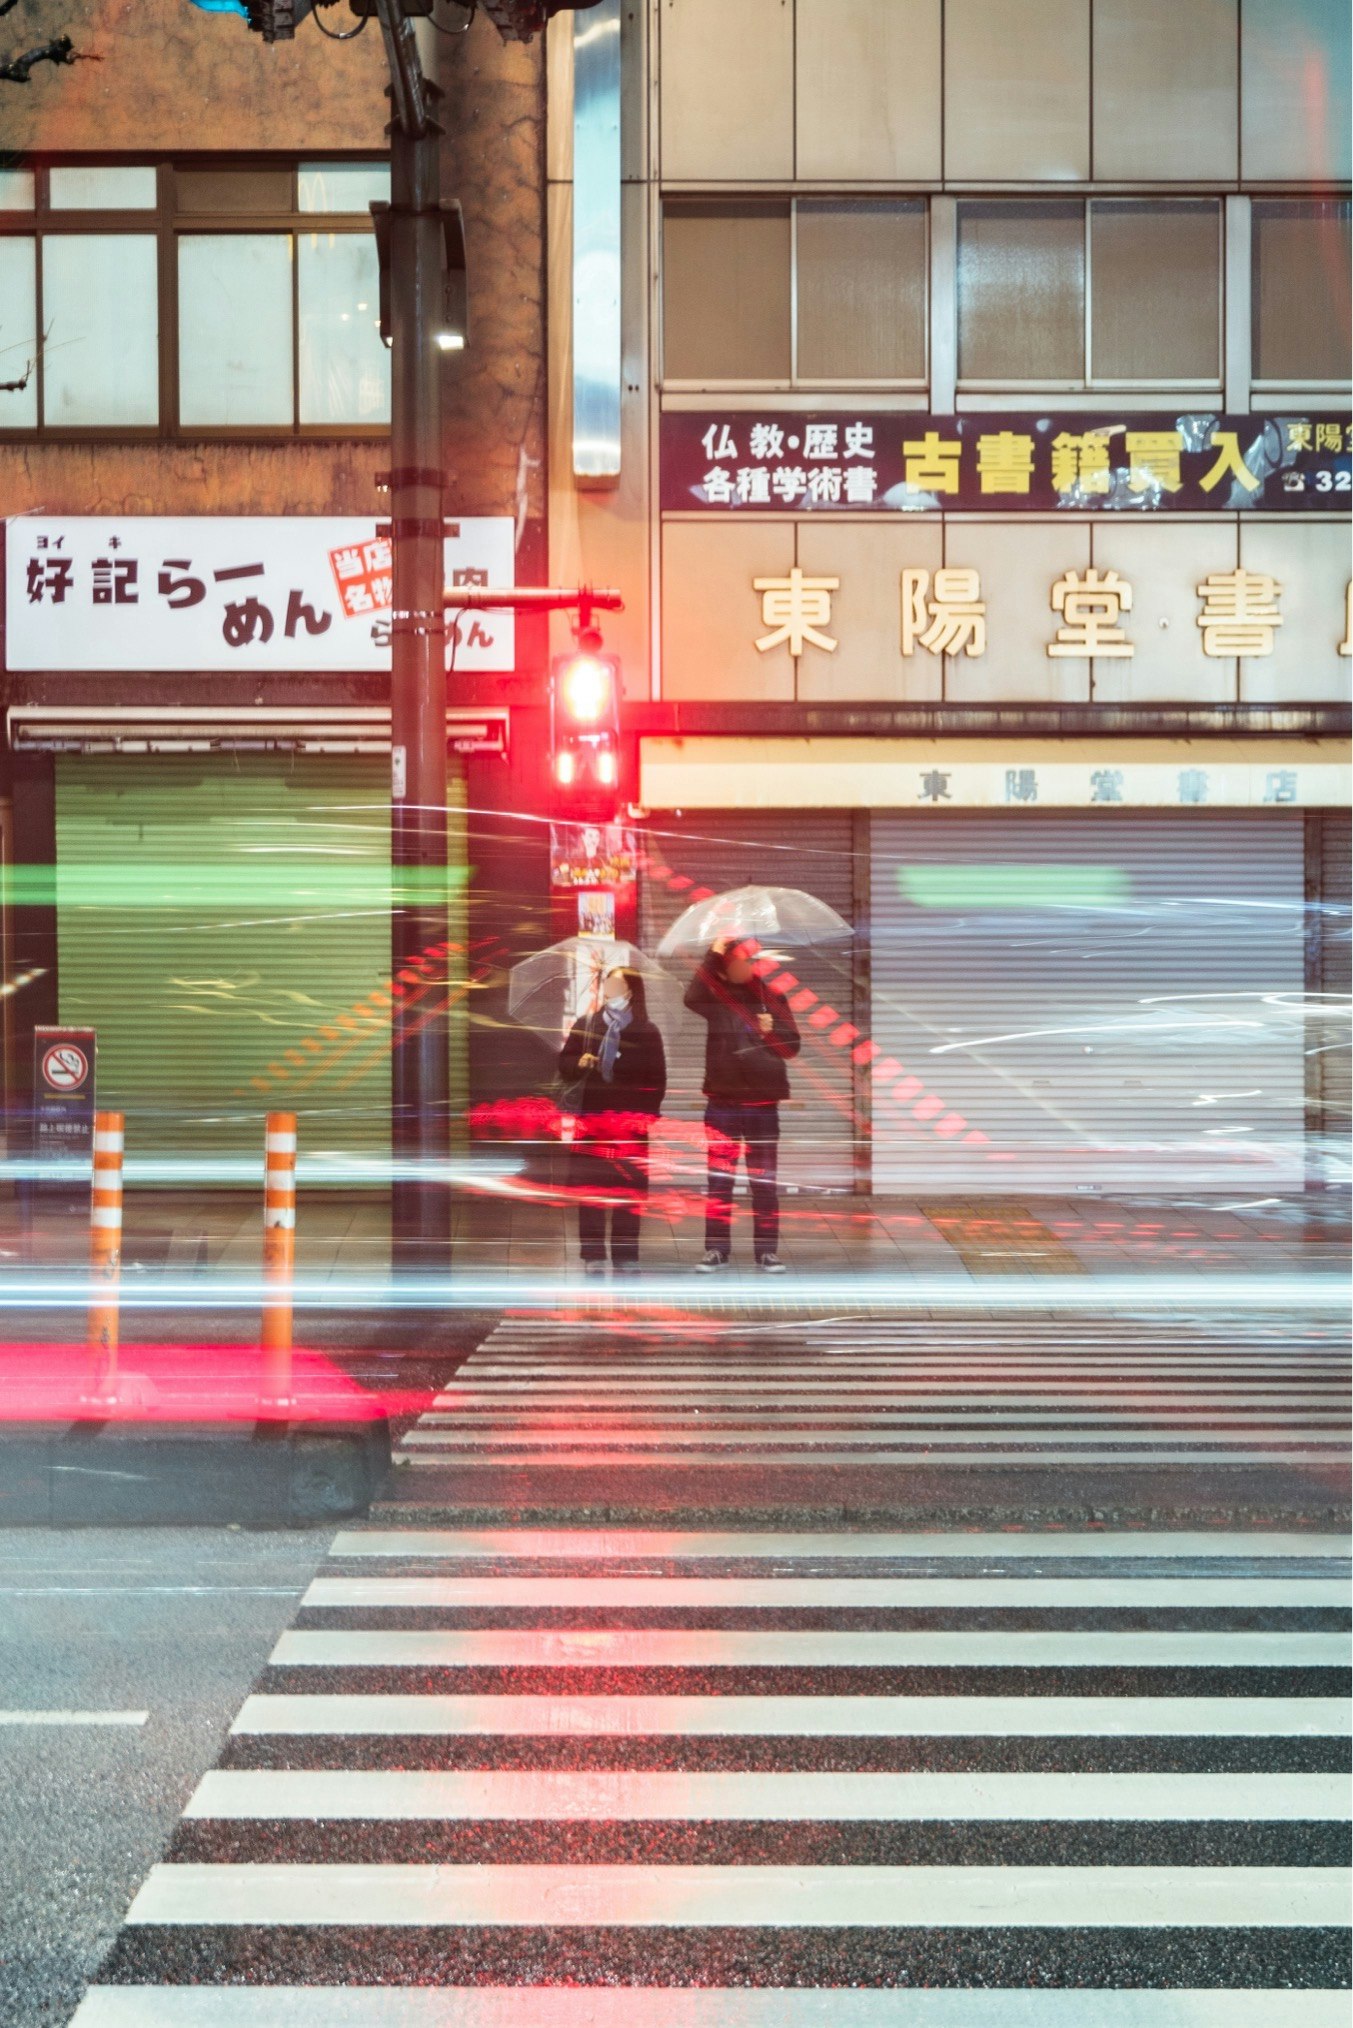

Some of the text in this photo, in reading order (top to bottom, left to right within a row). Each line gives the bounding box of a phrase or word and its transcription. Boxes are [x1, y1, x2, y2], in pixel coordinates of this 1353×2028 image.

[702, 422, 875, 460] 仏教・歴史
[1286, 422, 1352, 453] 東陽
[902, 431, 1261, 495] 古書籍買入
[703, 466, 878, 503] 各種学術書
[752, 567, 1352, 659] 東陽堂書
[370, 619, 494, 648] らめん
[917, 768, 1300, 803] 東陽堂書店
